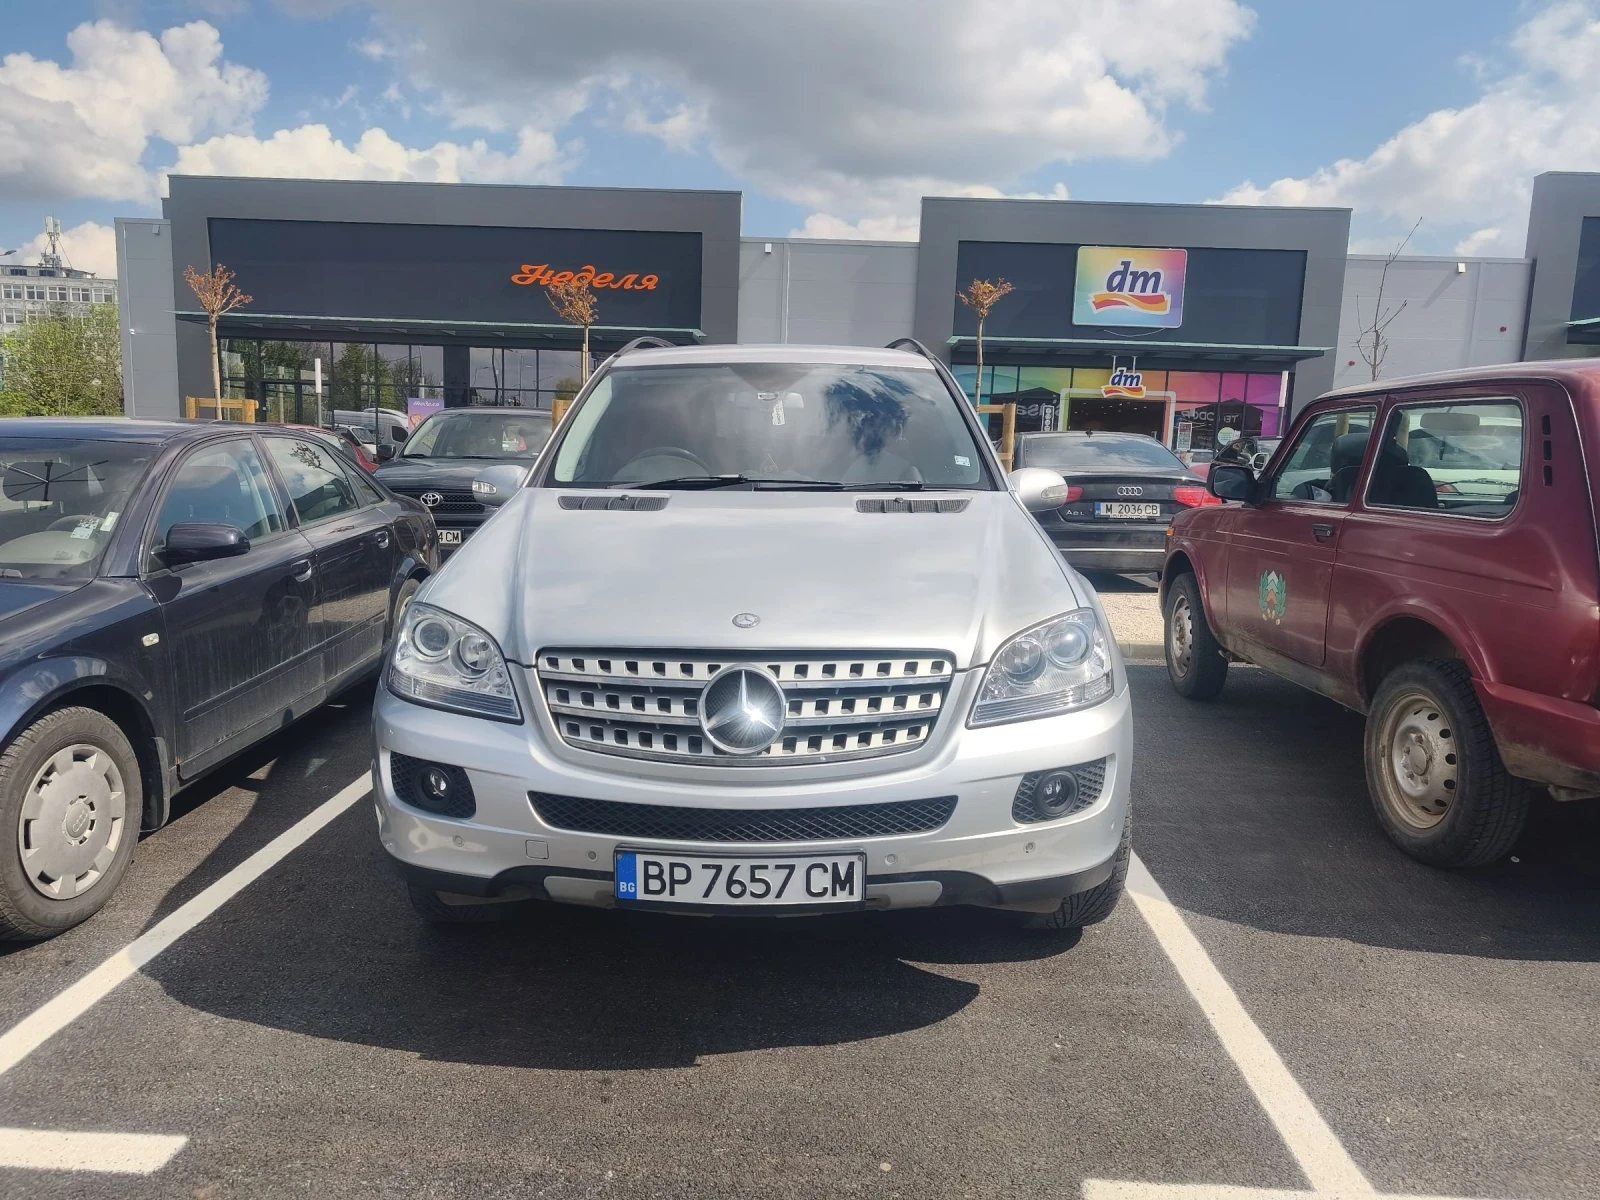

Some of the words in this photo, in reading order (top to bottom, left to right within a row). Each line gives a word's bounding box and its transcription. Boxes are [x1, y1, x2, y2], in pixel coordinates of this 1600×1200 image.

[511, 263, 659, 290] Неделя
[1106, 260, 1162, 294] dm
[1111, 369, 1141, 387] dm
[1105, 503, 1113, 514] M
[1117, 504, 1143, 515] 2036
[1144, 504, 1159, 515] CB
[445, 531, 460, 542] CM
[619, 881, 636, 893] BG
[643, 860, 692, 897] BP
[701, 864, 796, 899] 7657
[805, 860, 856, 898] CM
